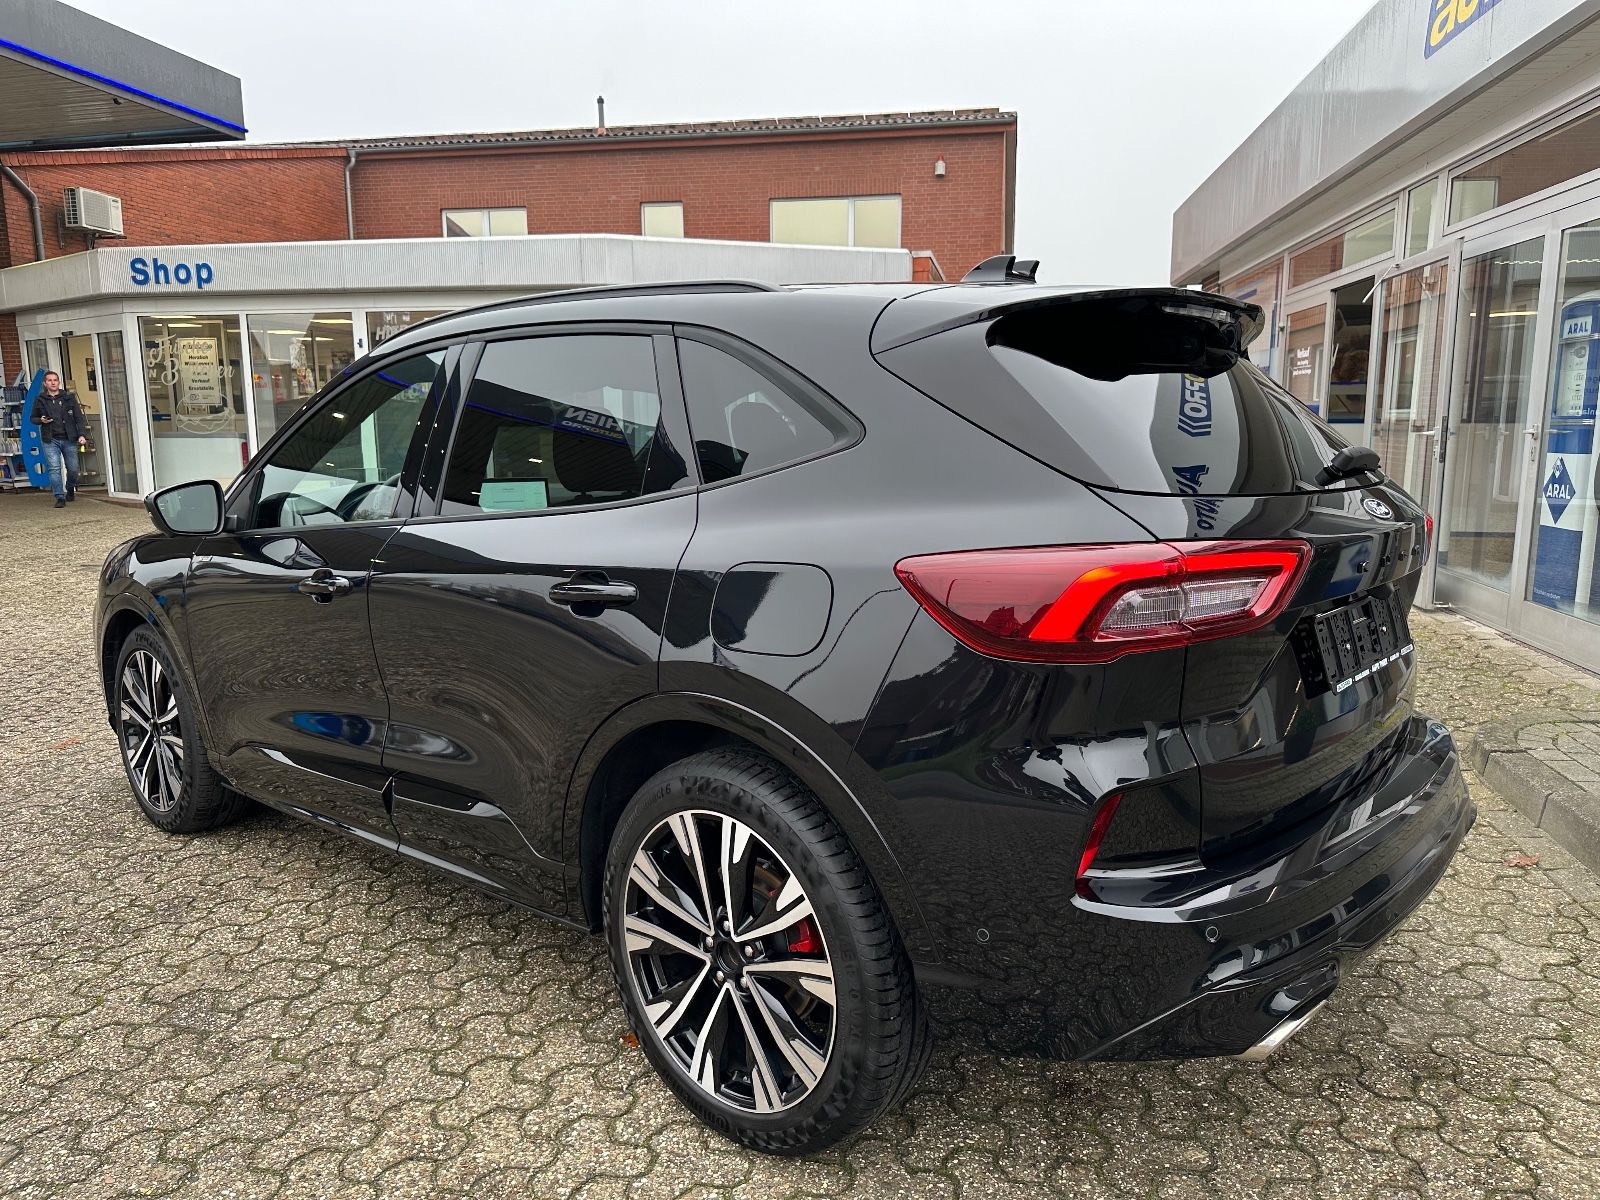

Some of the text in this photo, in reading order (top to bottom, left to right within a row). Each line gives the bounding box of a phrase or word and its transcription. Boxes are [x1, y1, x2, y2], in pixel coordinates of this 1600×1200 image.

[130, 257, 213, 289] Shop
[1567, 320, 1589, 335] ARAL
[1545, 483, 1571, 500] ARAL
